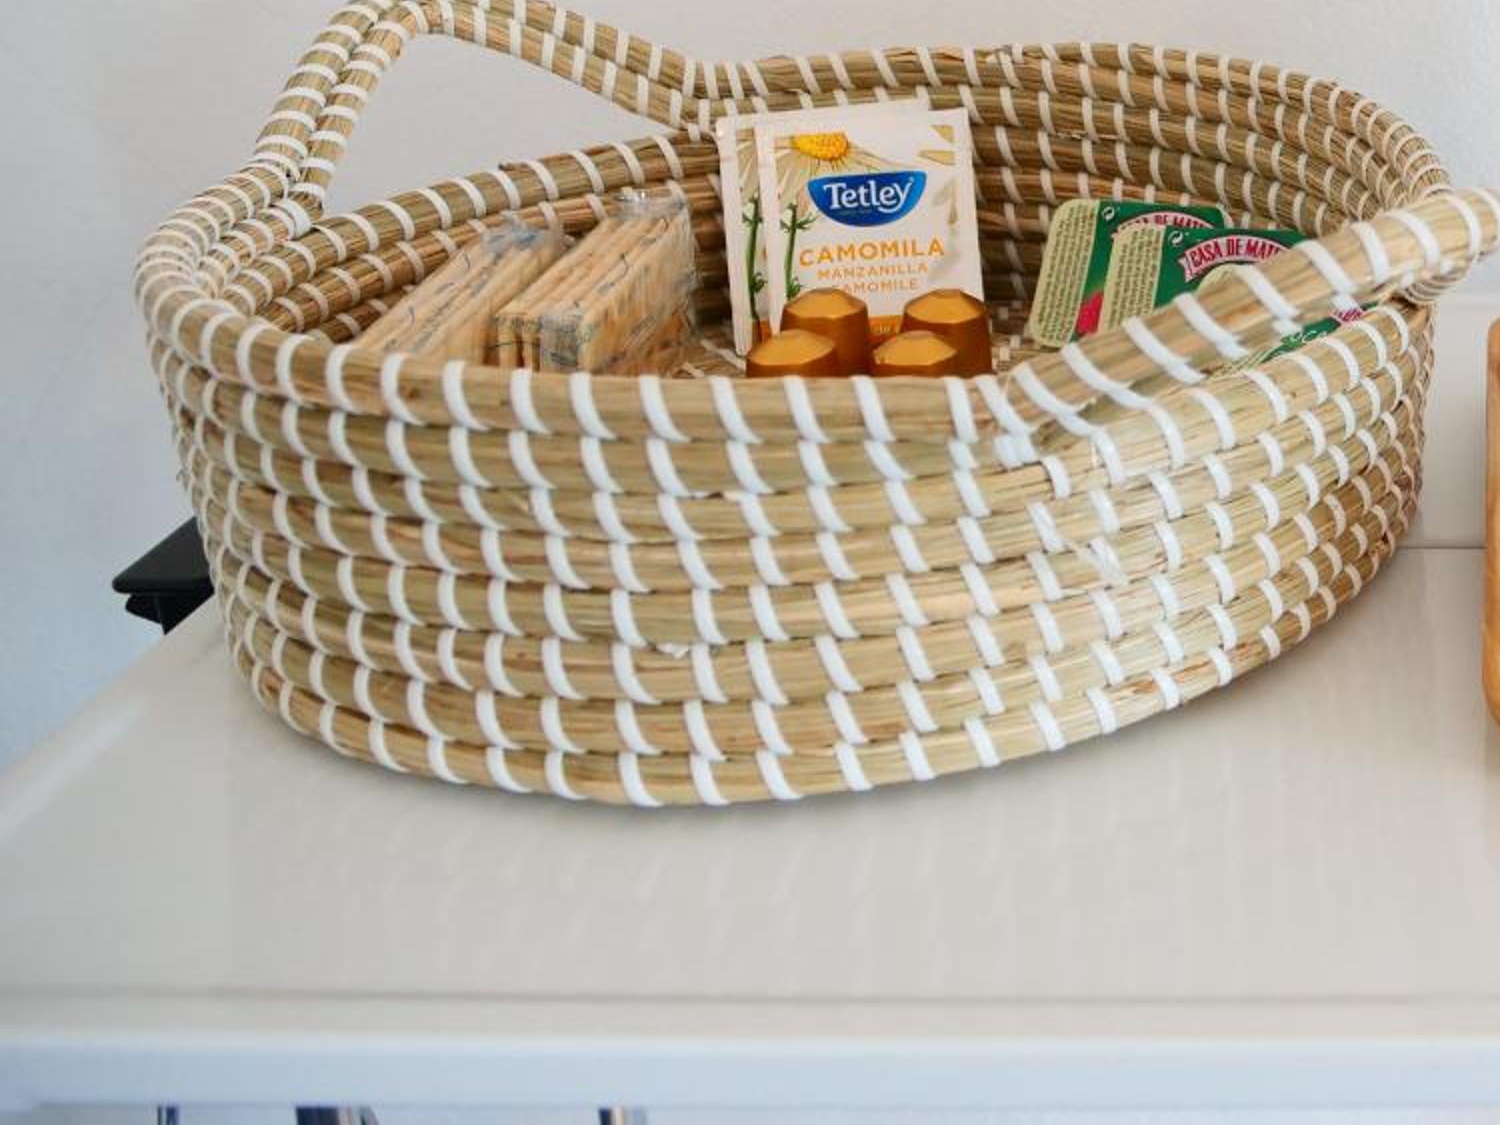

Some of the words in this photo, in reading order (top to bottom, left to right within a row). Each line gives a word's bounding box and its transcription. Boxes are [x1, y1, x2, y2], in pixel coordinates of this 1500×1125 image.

[822, 179, 912, 213] Tetley
[800, 238, 945, 267] CAMOMILA
[1189, 239, 1223, 268] CASA
[1226, 238, 1244, 257] DE
[817, 262, 929, 280] MANZANILLA
[835, 278, 920, 293] AMOMILE
